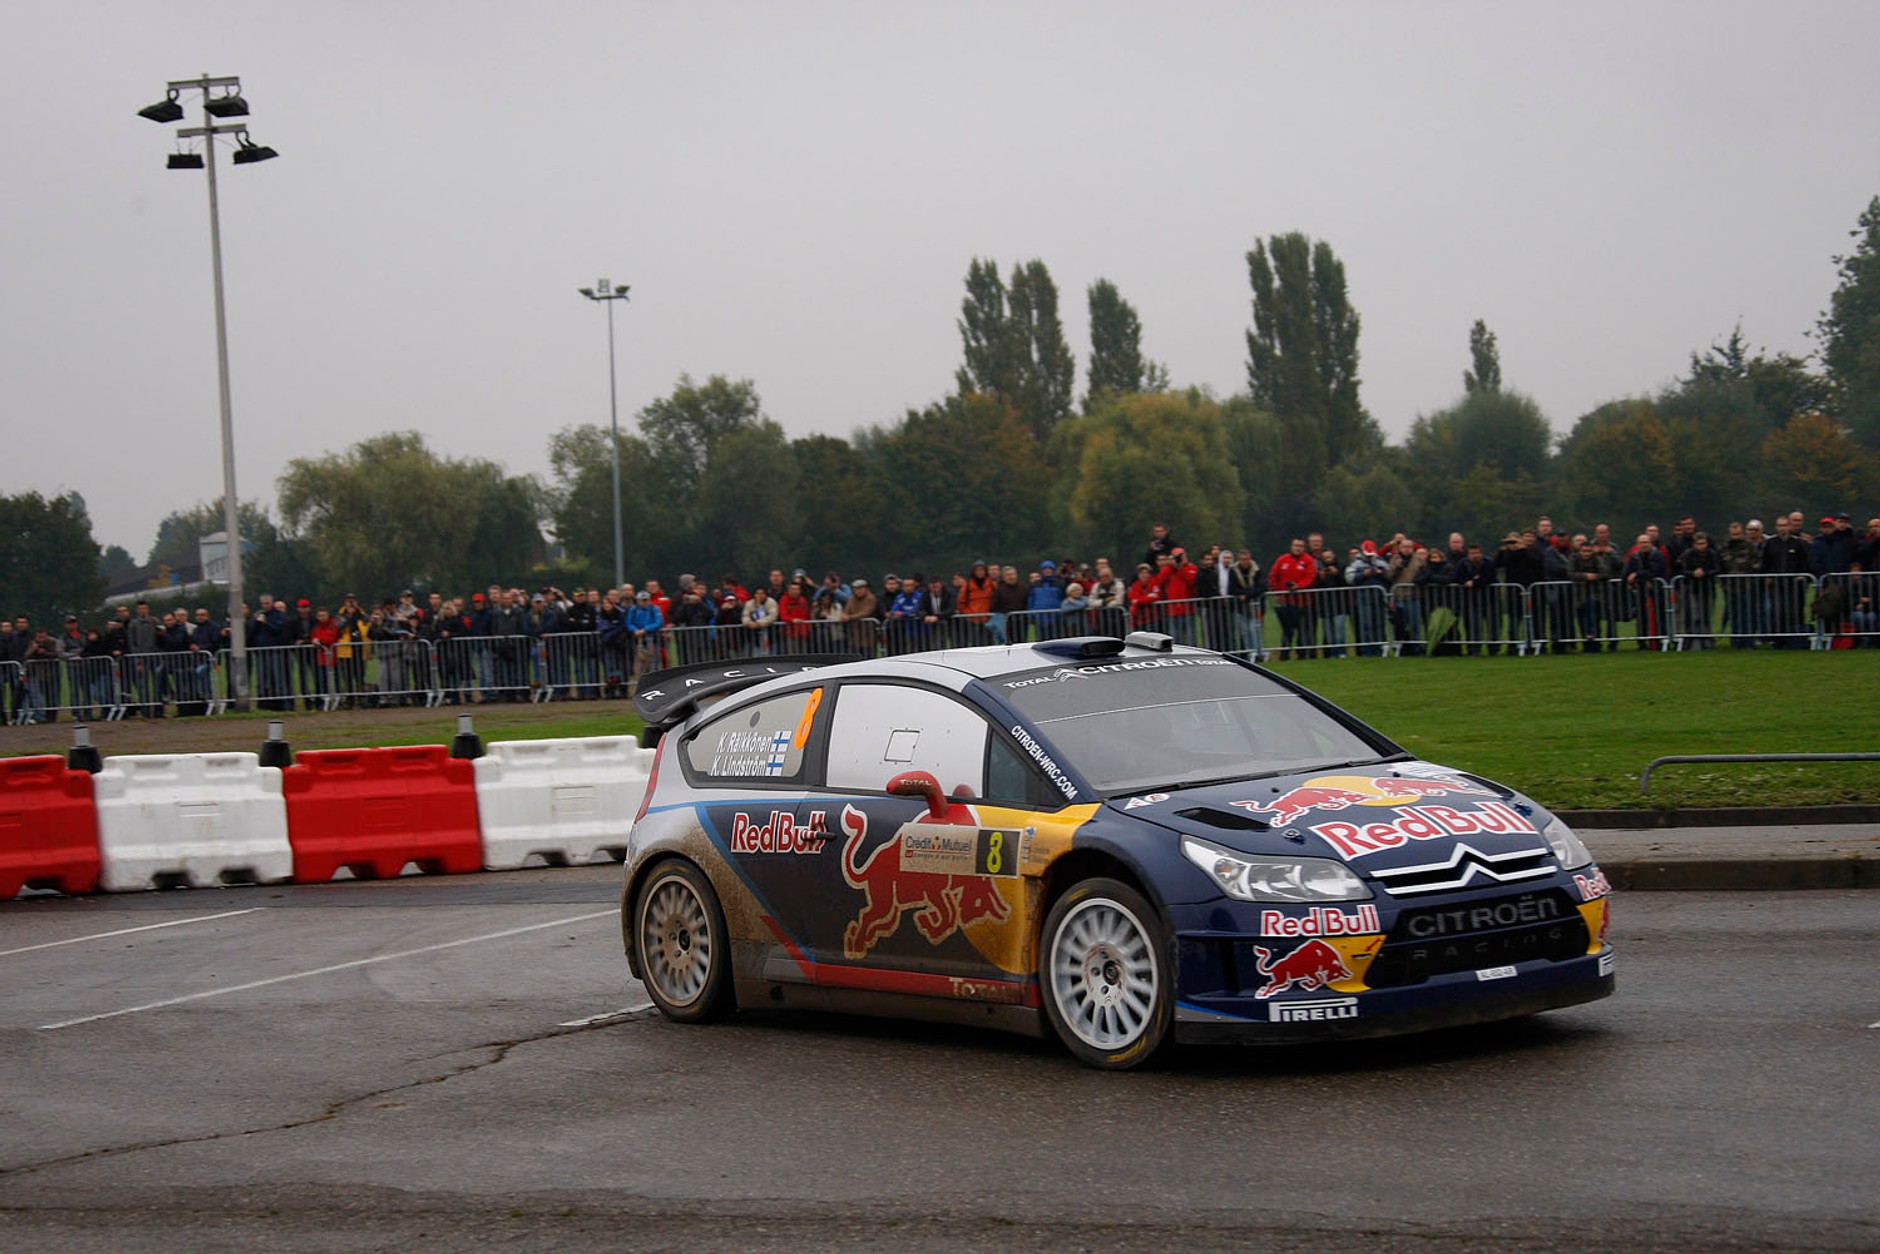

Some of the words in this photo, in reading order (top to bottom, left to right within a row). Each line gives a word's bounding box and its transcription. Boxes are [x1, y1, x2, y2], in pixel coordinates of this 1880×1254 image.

[1003, 676, 1057, 689] TOTAL
[794, 687, 823, 749] 8
[1011, 725, 1078, 800] CITROEN-WRC.COM
[900, 778, 933, 786] TOTAL
[986, 831, 1004, 874] 8
[1268, 997, 1359, 1022] PIRELLI
